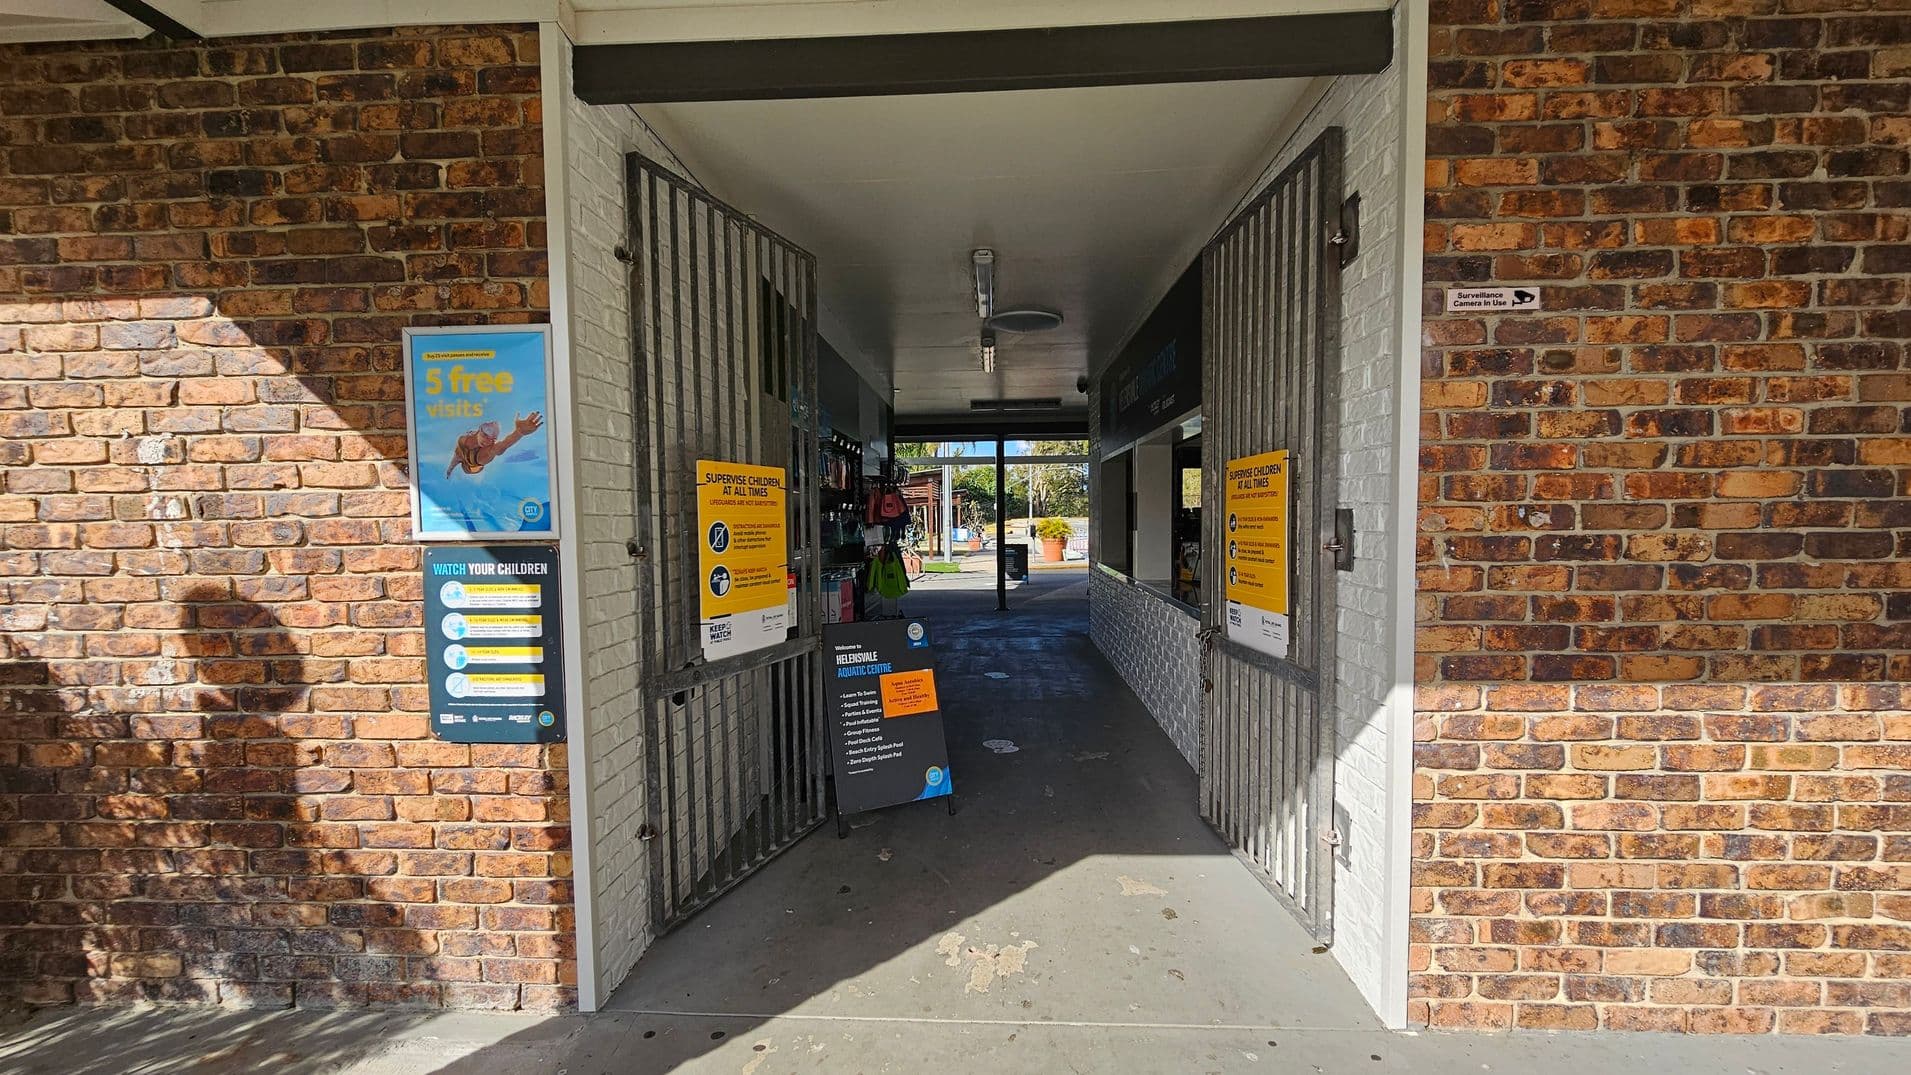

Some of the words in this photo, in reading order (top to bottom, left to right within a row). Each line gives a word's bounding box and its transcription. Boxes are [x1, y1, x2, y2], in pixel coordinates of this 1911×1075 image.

[426, 368, 442, 395] 5
[448, 365, 514, 393] free
[1230, 468, 1253, 480] SUPERVISE
[1254, 464, 1281, 477] CHILDREN
[706, 473, 746, 485] SUPERVISE
[748, 476, 780, 487] CHILDREN
[1238, 480, 1243, 490] AT
[1254, 478, 1269, 488] TIMES
[723, 486, 732, 495] AT
[734, 487, 746, 496] ALL
[749, 488, 768, 497] TIMES
[433, 564, 466, 575] WATCH
[468, 563, 495, 575] YOUR
[498, 562, 548, 575] CHILDREN
[710, 624, 726, 632] KEEP
[710, 630, 731, 640] WATCH
[836, 652, 878, 665] HELENSVALE
[838, 665, 866, 678] AQUATIC
[867, 663, 892, 674] CENTRE
